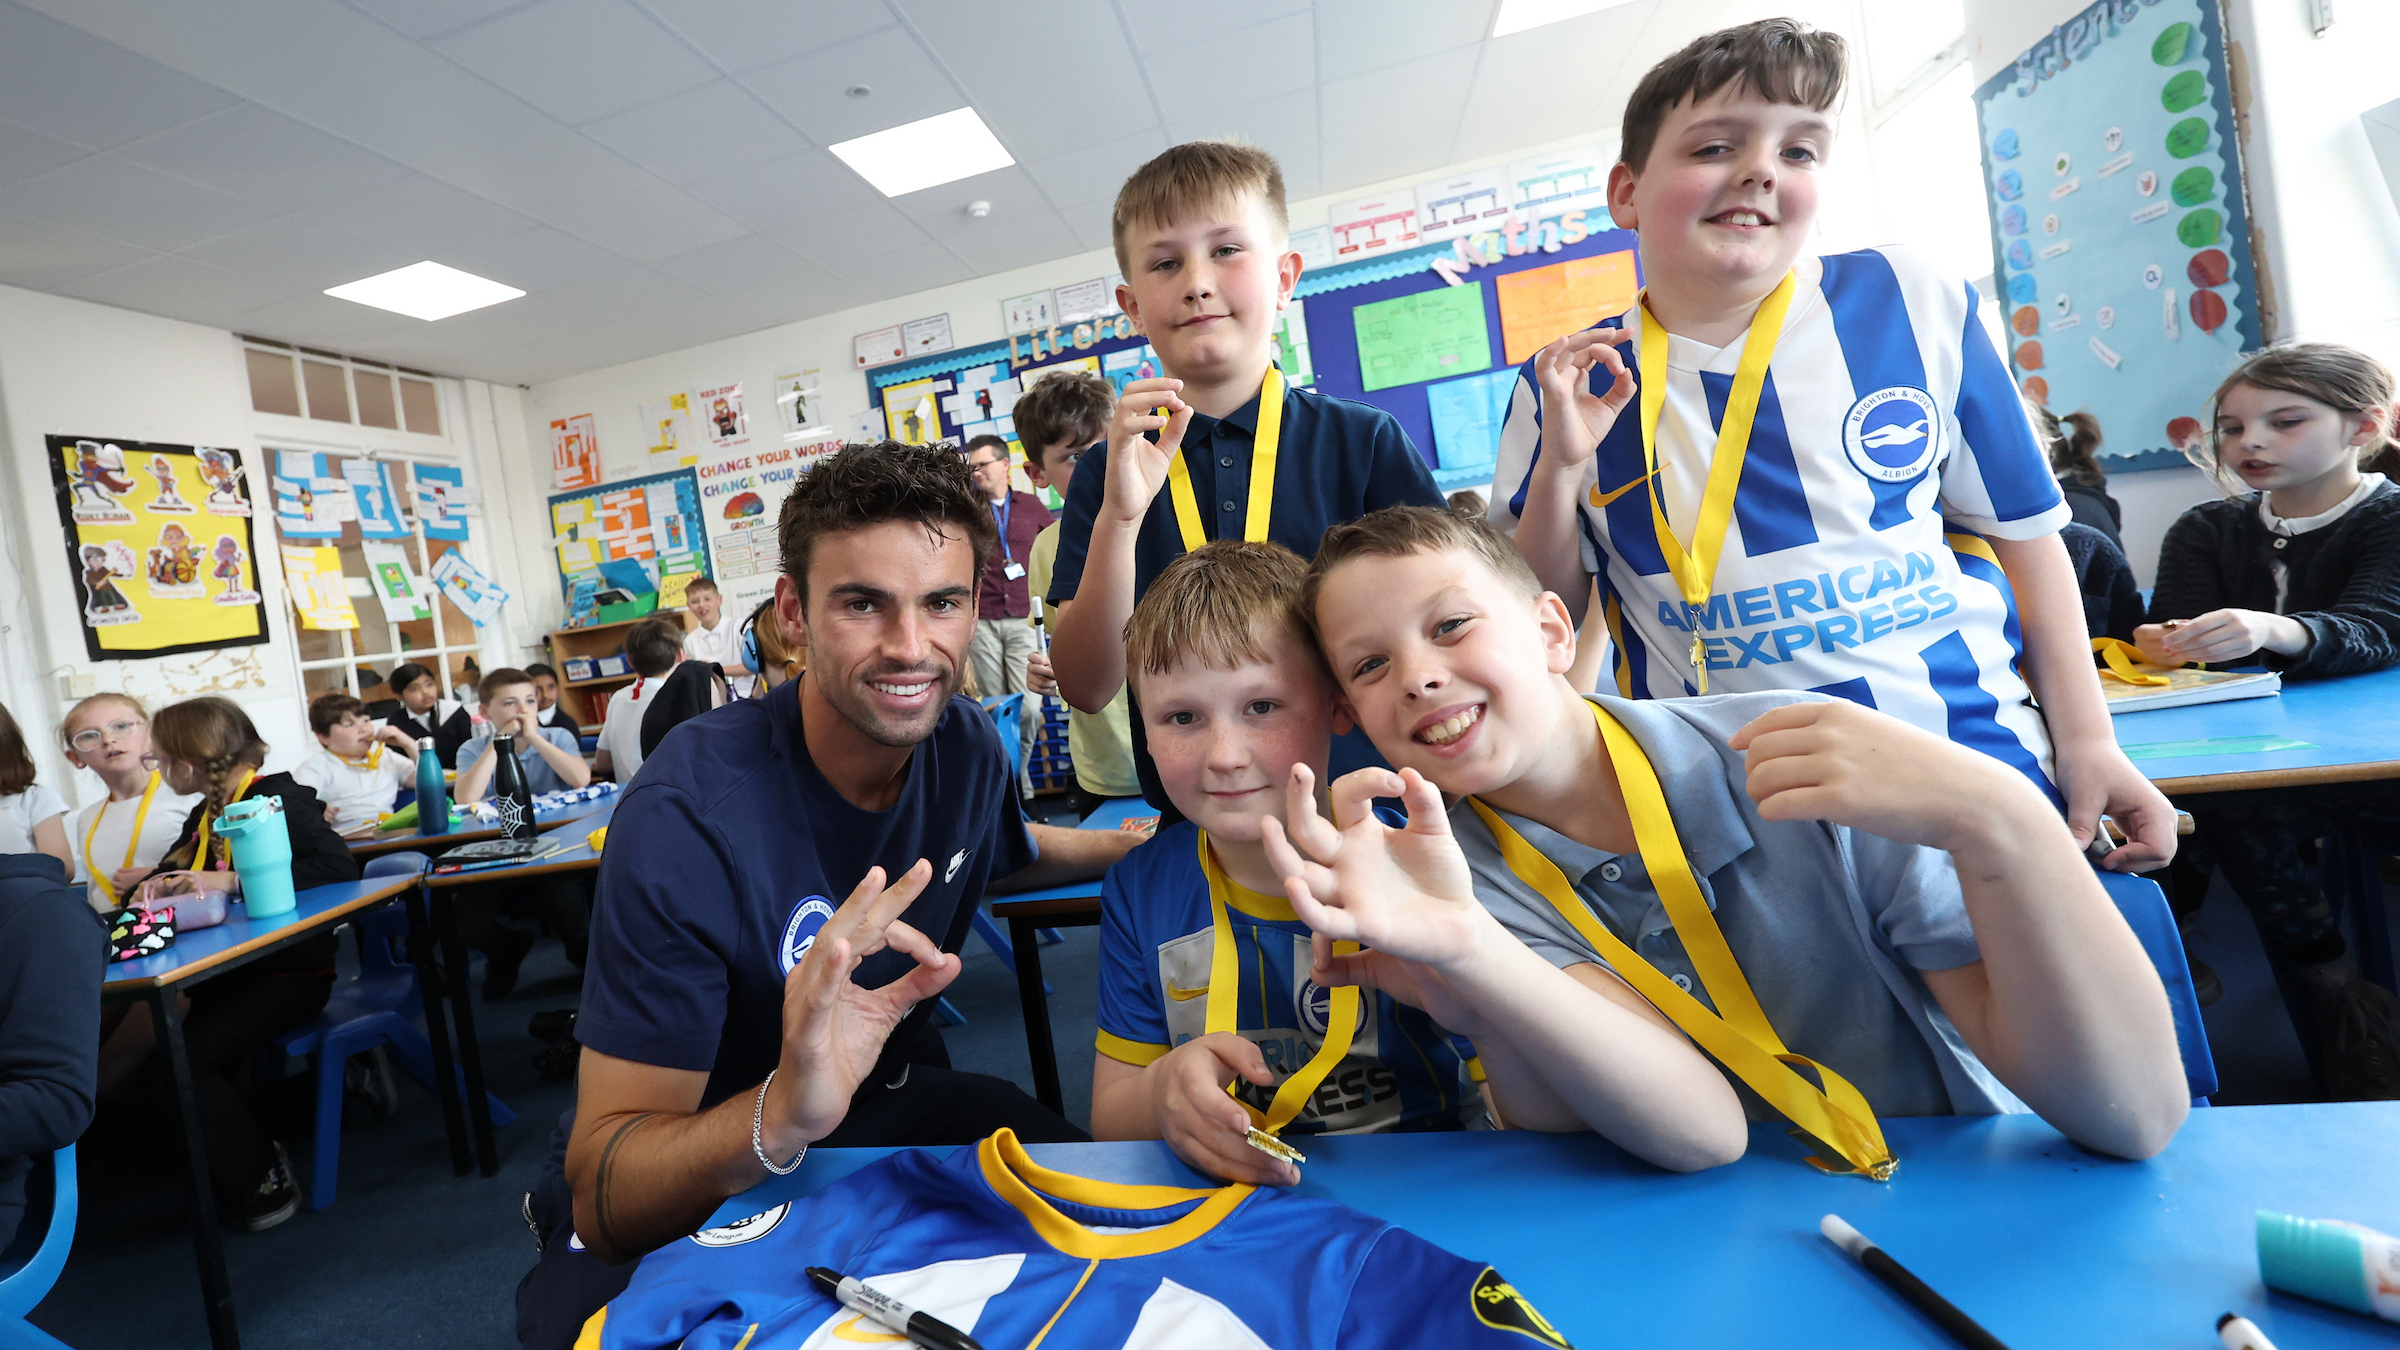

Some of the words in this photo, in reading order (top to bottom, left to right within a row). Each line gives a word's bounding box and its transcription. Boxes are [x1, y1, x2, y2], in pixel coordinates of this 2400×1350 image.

[2015, 0, 2162, 98] Scienc
[1430, 206, 1588, 287] Maths
[1009, 314, 1140, 369] Litera
[700, 389, 717, 398] RED
[1851, 391, 1896, 422] BRIGHTON
[1913, 392, 1932, 410] HOVE
[700, 457, 752, 478] CHANGE
[756, 449, 792, 466] YOUR
[795, 438, 844, 458] WORDS
[1881, 465, 1918, 478] ALBION
[703, 476, 756, 497] CHANGE
[760, 468, 795, 484] YOUR
[730, 518, 765, 531] GROWTH
[736, 591, 758, 599] Green
[1657, 551, 1935, 632] AMERICAN
[1705, 584, 1958, 670] EXPRESS
[788, 904, 812, 936] BRIGHTON
[819, 904, 833, 917] HOVE
[712, 1232, 743, 1240] League
